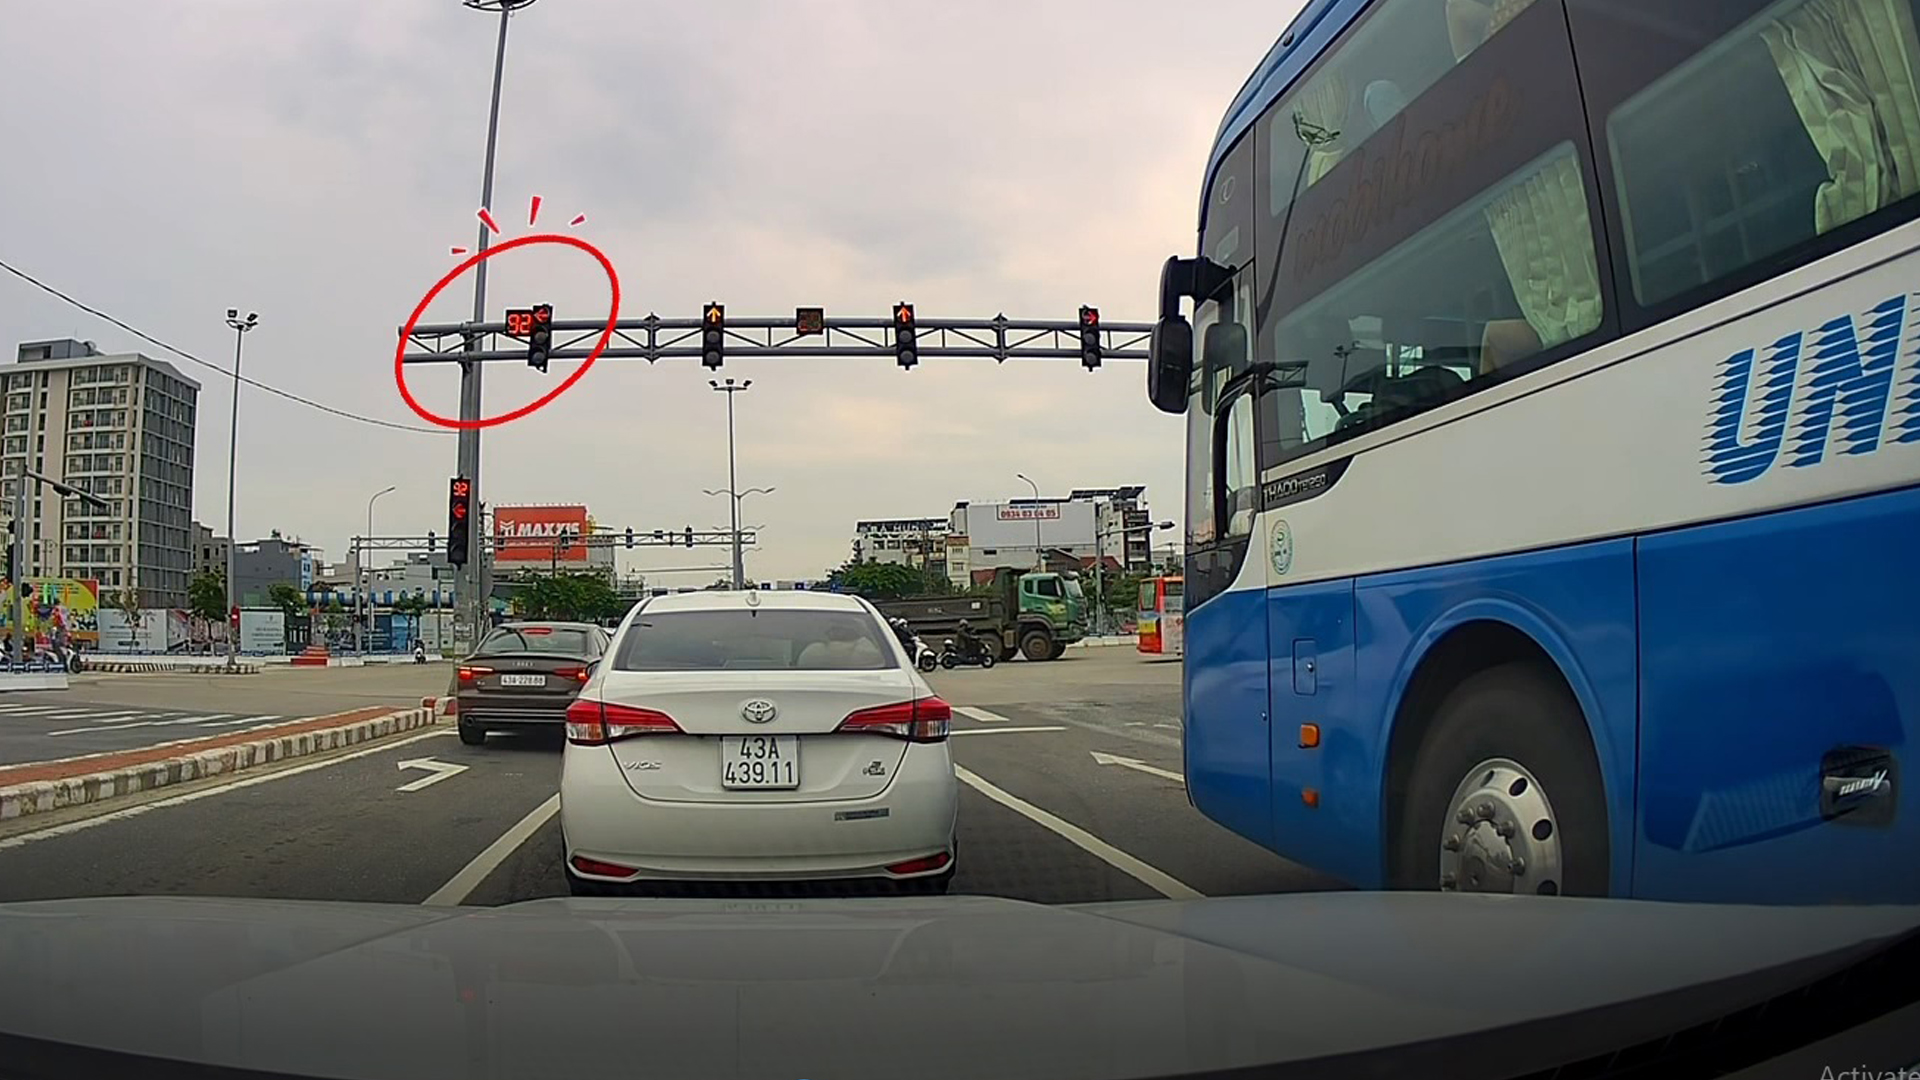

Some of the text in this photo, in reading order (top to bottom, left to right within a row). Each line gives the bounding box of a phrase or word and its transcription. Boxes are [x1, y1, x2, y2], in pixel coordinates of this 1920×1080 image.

[508, 313, 532, 335] 92
[453, 481, 468, 497] 92
[516, 522, 580, 538] MAXXIS
[740, 736, 780, 760] 43A
[725, 761, 793, 784] 439.11
